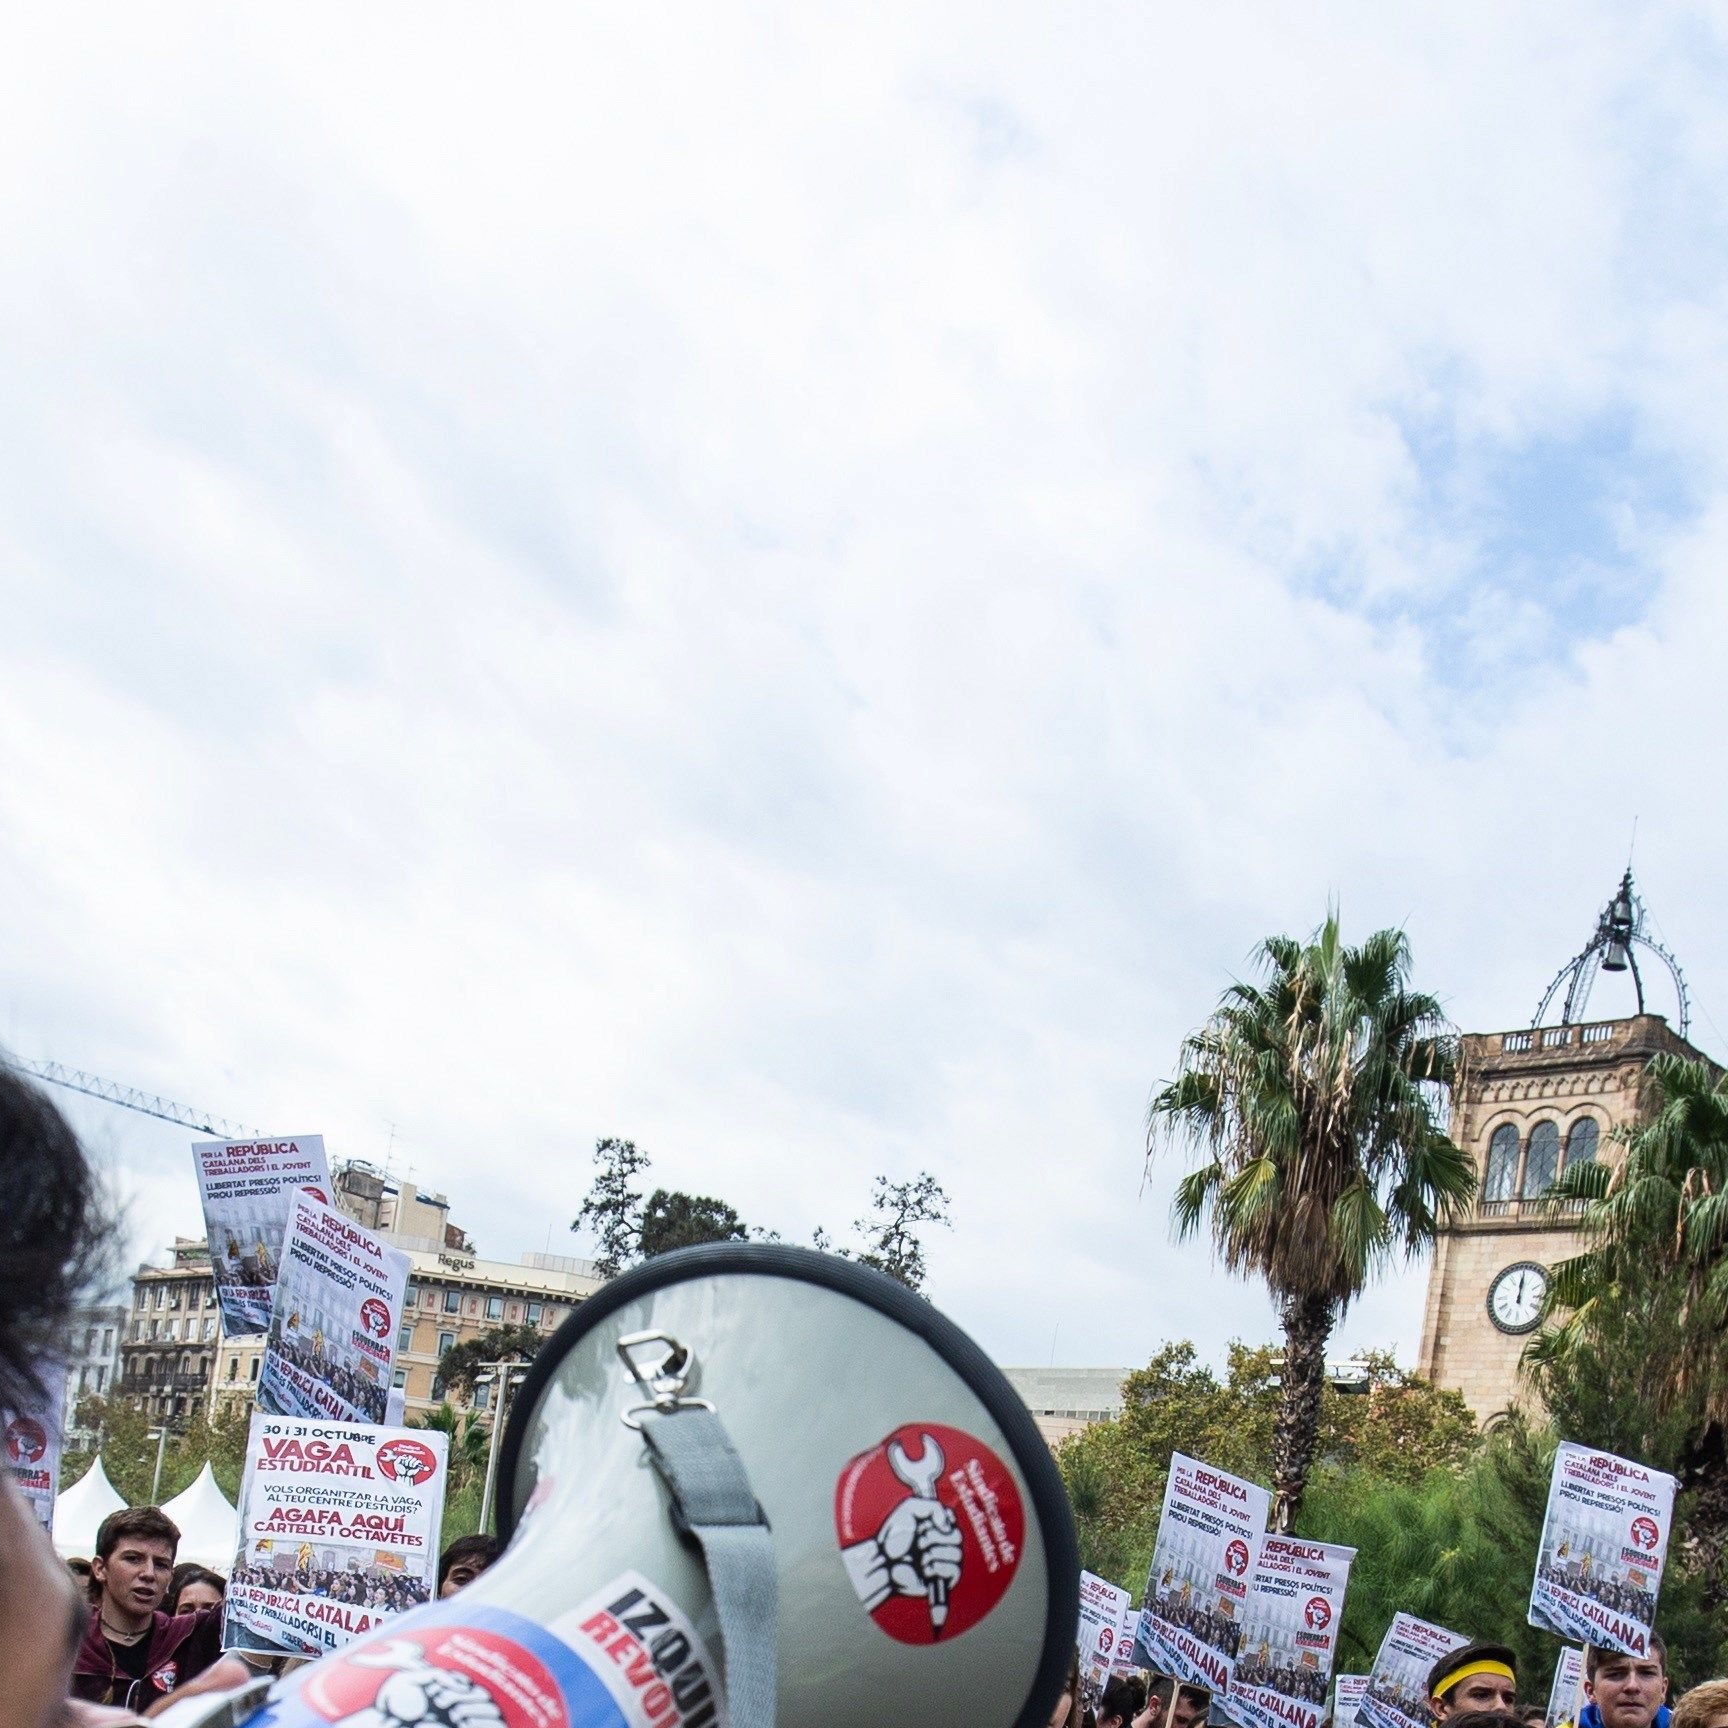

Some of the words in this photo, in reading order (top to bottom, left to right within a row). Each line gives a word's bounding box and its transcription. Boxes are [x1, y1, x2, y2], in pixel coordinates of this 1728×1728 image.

[226, 1142, 299, 1157] REPÚBLICA
[203, 1159, 245, 1168] CATALANA
[204, 1166, 264, 1176] TREBALLADORS
[282, 1162, 311, 1170] JOVENT
[206, 1180, 246, 1191] LLIBERTAT
[250, 1177, 280, 1186] PRESOS
[283, 1175, 321, 1184] POLÍTICS!
[207, 1191, 232, 1199] PROU
[235, 1187, 281, 1198] REPRESSIÓ!
[297, 1214, 335, 1242] CATALANA
[336, 1237, 351, 1251] DELS
[322, 1213, 382, 1260] REPÚBLICA
[296, 1221, 347, 1259] TREBALLADORS
[363, 1262, 388, 1282] JOVENT
[438, 1253, 474, 1271] Regus
[290, 1247, 313, 1266] PROU
[314, 1262, 354, 1291] REPRESSIÓ!
[292, 1237, 329, 1263] LLIBERTAT
[331, 1259, 357, 1281] PRESOS
[359, 1276, 393, 1301] POLÍTICS!
[263, 1424, 281, 1435] 30
[295, 1427, 307, 1436] 31
[261, 1437, 355, 1465] VAGA
[256, 1458, 375, 1481] ESTUDIANTIL
[1564, 1467, 1614, 1489] TREBALLADORS
[1565, 1461, 1600, 1477] CATALANA
[1602, 1473, 1618, 1482] DELS
[1589, 1456, 1649, 1482] REPÚBLICA
[264, 1484, 293, 1494] VOLS
[296, 1487, 372, 1501] ORGANITZAR
[374, 1495, 389, 1504] LA
[391, 1496, 423, 1507] VAGA
[1174, 1485, 1217, 1508] TREBALLADORS
[1175, 1476, 1206, 1495] CATALANA
[1208, 1490, 1221, 1500] DELS
[1196, 1469, 1247, 1502] REPÚBLICA
[266, 1494, 282, 1502] AL
[285, 1494, 307, 1504] TEU
[308, 1496, 352, 1508] CENTRE
[354, 1500, 418, 1515] D'ESTUDIS?
[1559, 1490, 1580, 1501] PROU
[1582, 1498, 1623, 1514] REPRESSIÓ!
[1561, 1480, 1594, 1496] LLIBERTAT
[1597, 1492, 1626, 1505] PRESOS
[1627, 1501, 1661, 1517] POLÍTICS!
[268, 1507, 343, 1526] AGAFA
[350, 1513, 406, 1533] AQUÍ
[1169, 1510, 1187, 1523] PROU
[1170, 1499, 1200, 1517] LLIBERTAT
[1201, 1512, 1224, 1528] PRESOS
[1225, 1522, 1253, 1539] POLÍTICS!
[254, 1522, 330, 1536] CARTELLS
[339, 1527, 423, 1547] OCTAVETES
[1266, 1541, 1324, 1561] REPÚBLICA
[1280, 1556, 1295, 1565] DELS
[1304, 1568, 1330, 1579] JOVENT
[1274, 1578, 1299, 1589] PRESOS
[1301, 1582, 1332, 1595] POLÍTICS!
[1582, 1602, 1645, 1656] CATALANA
[1177, 1635, 1228, 1696] CATALANA
